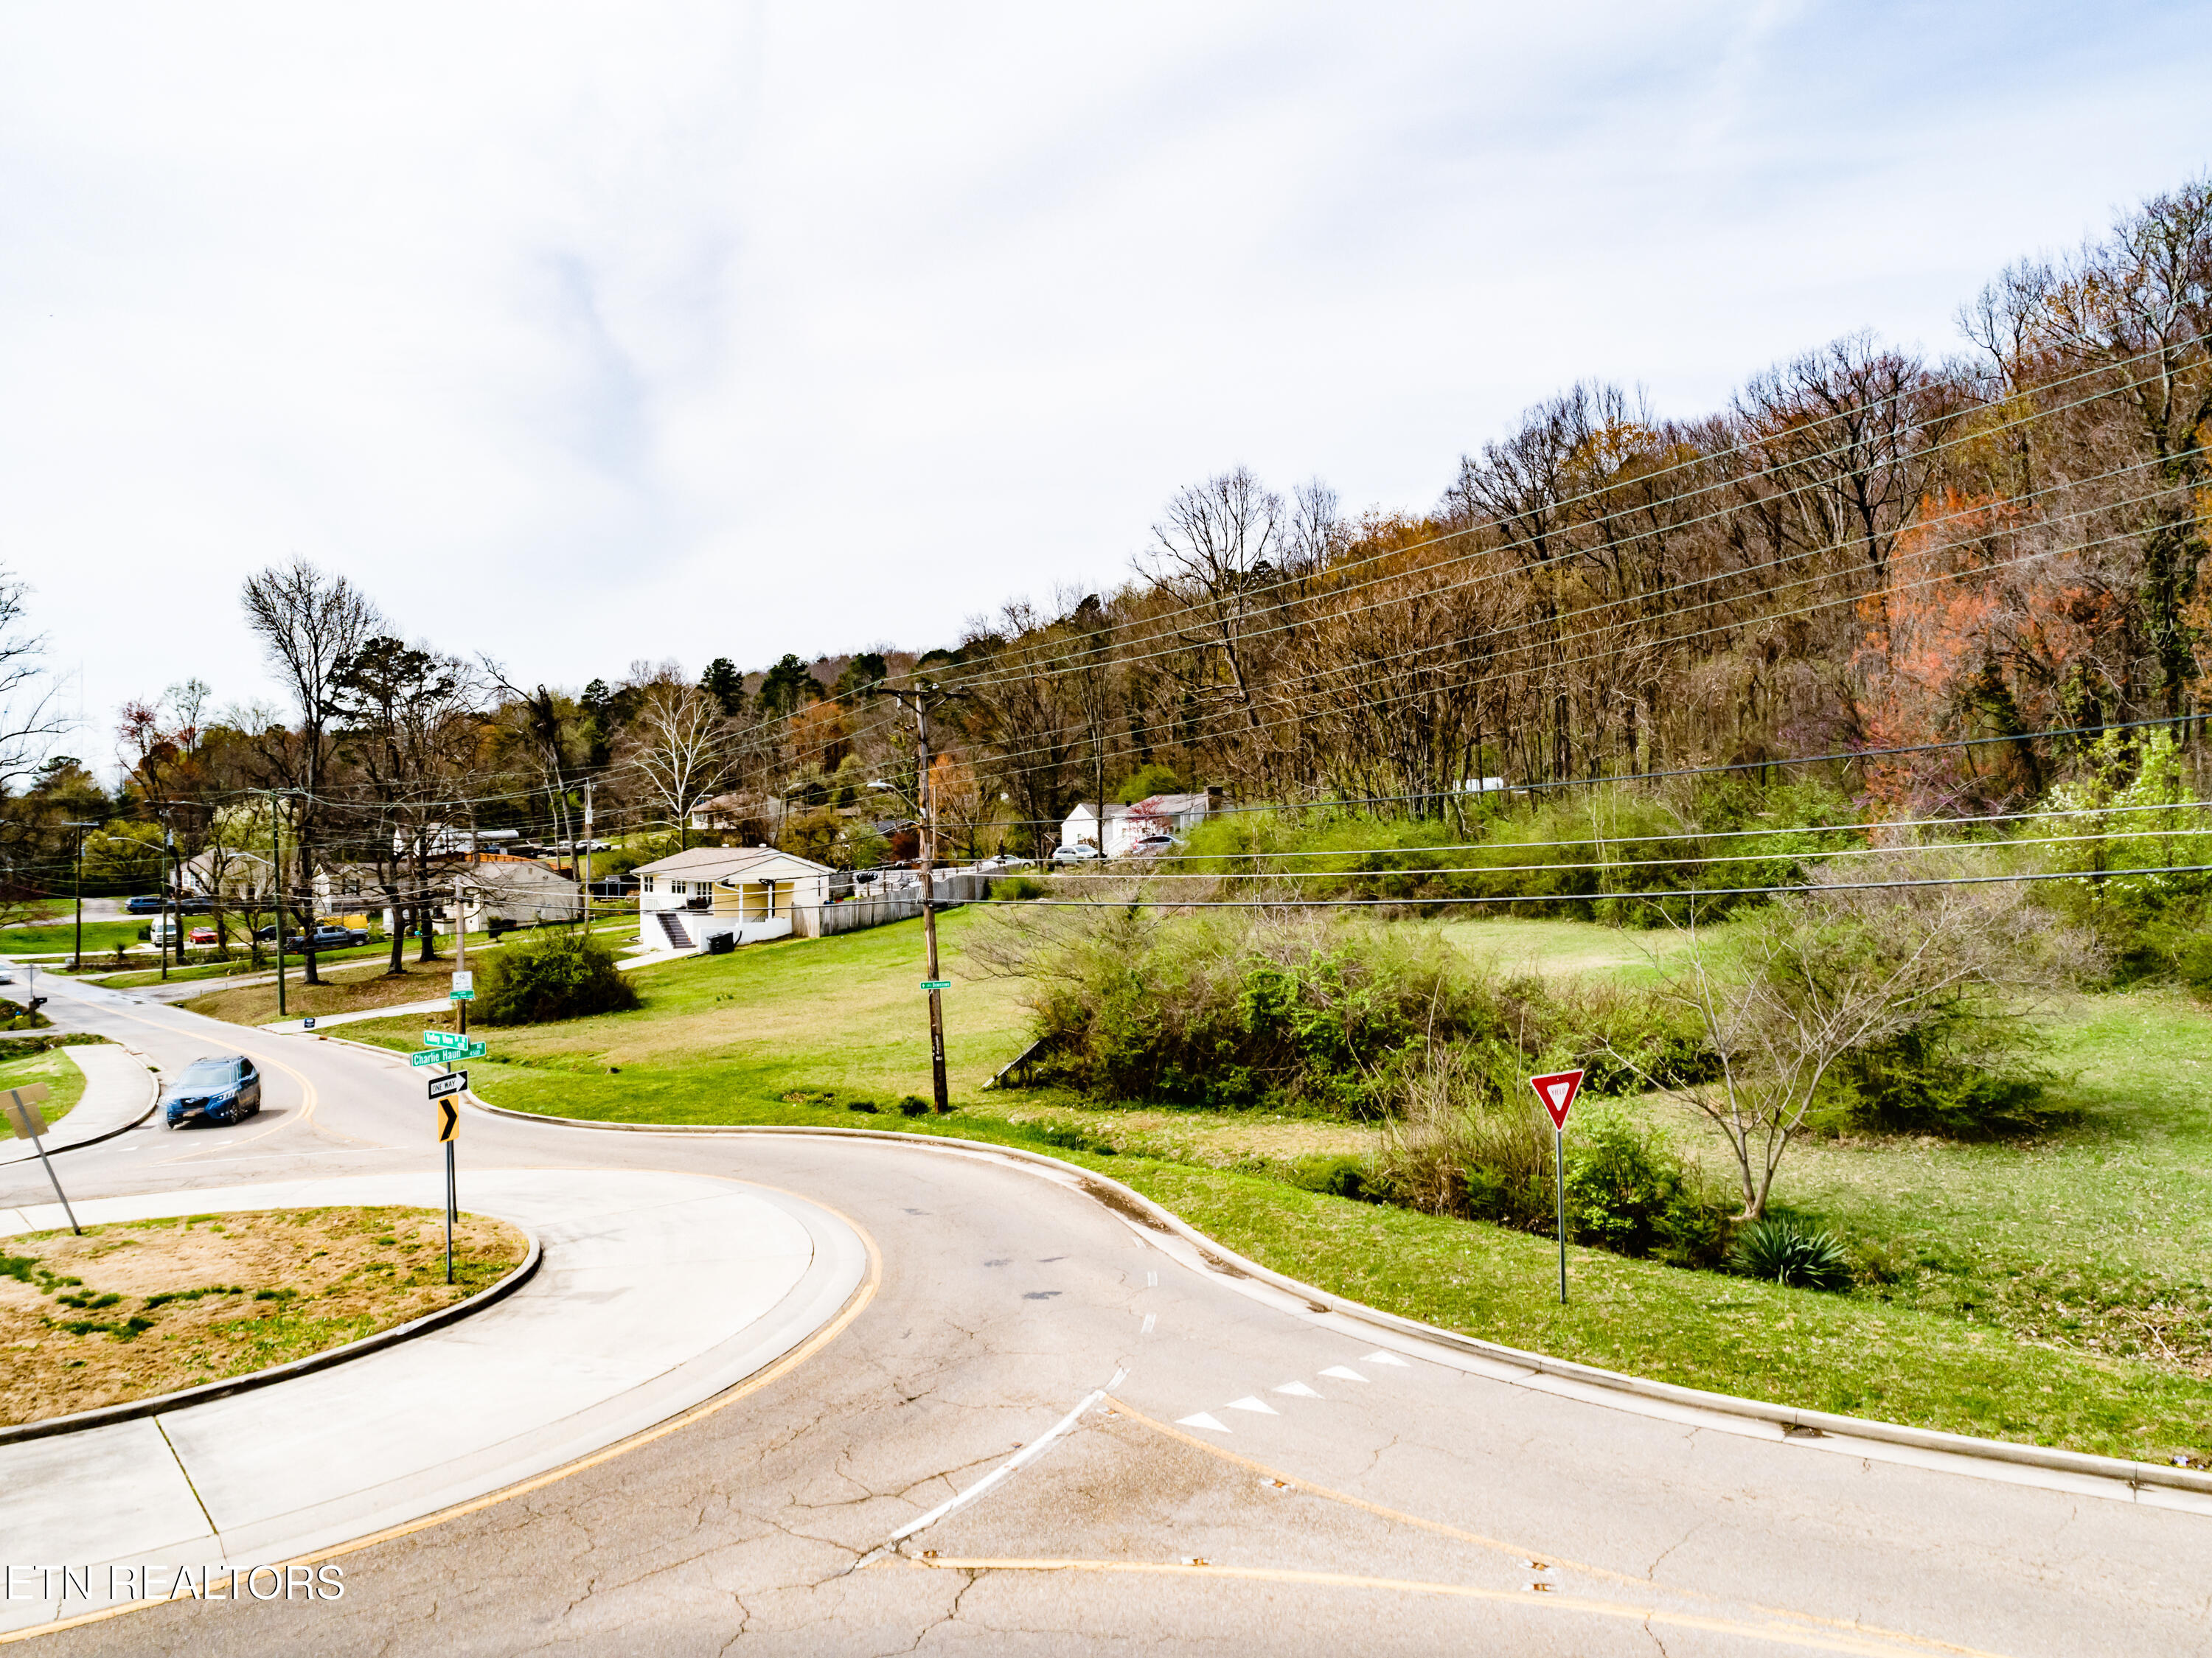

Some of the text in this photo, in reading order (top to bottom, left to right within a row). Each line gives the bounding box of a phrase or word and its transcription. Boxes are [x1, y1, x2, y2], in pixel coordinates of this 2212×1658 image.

[426, 1032, 440, 1045] Valley
[414, 1049, 461, 1065] Charlie Haun
[432, 1079, 456, 1093] ONE WAY
[1551, 1087, 1566, 1096] YIELD
